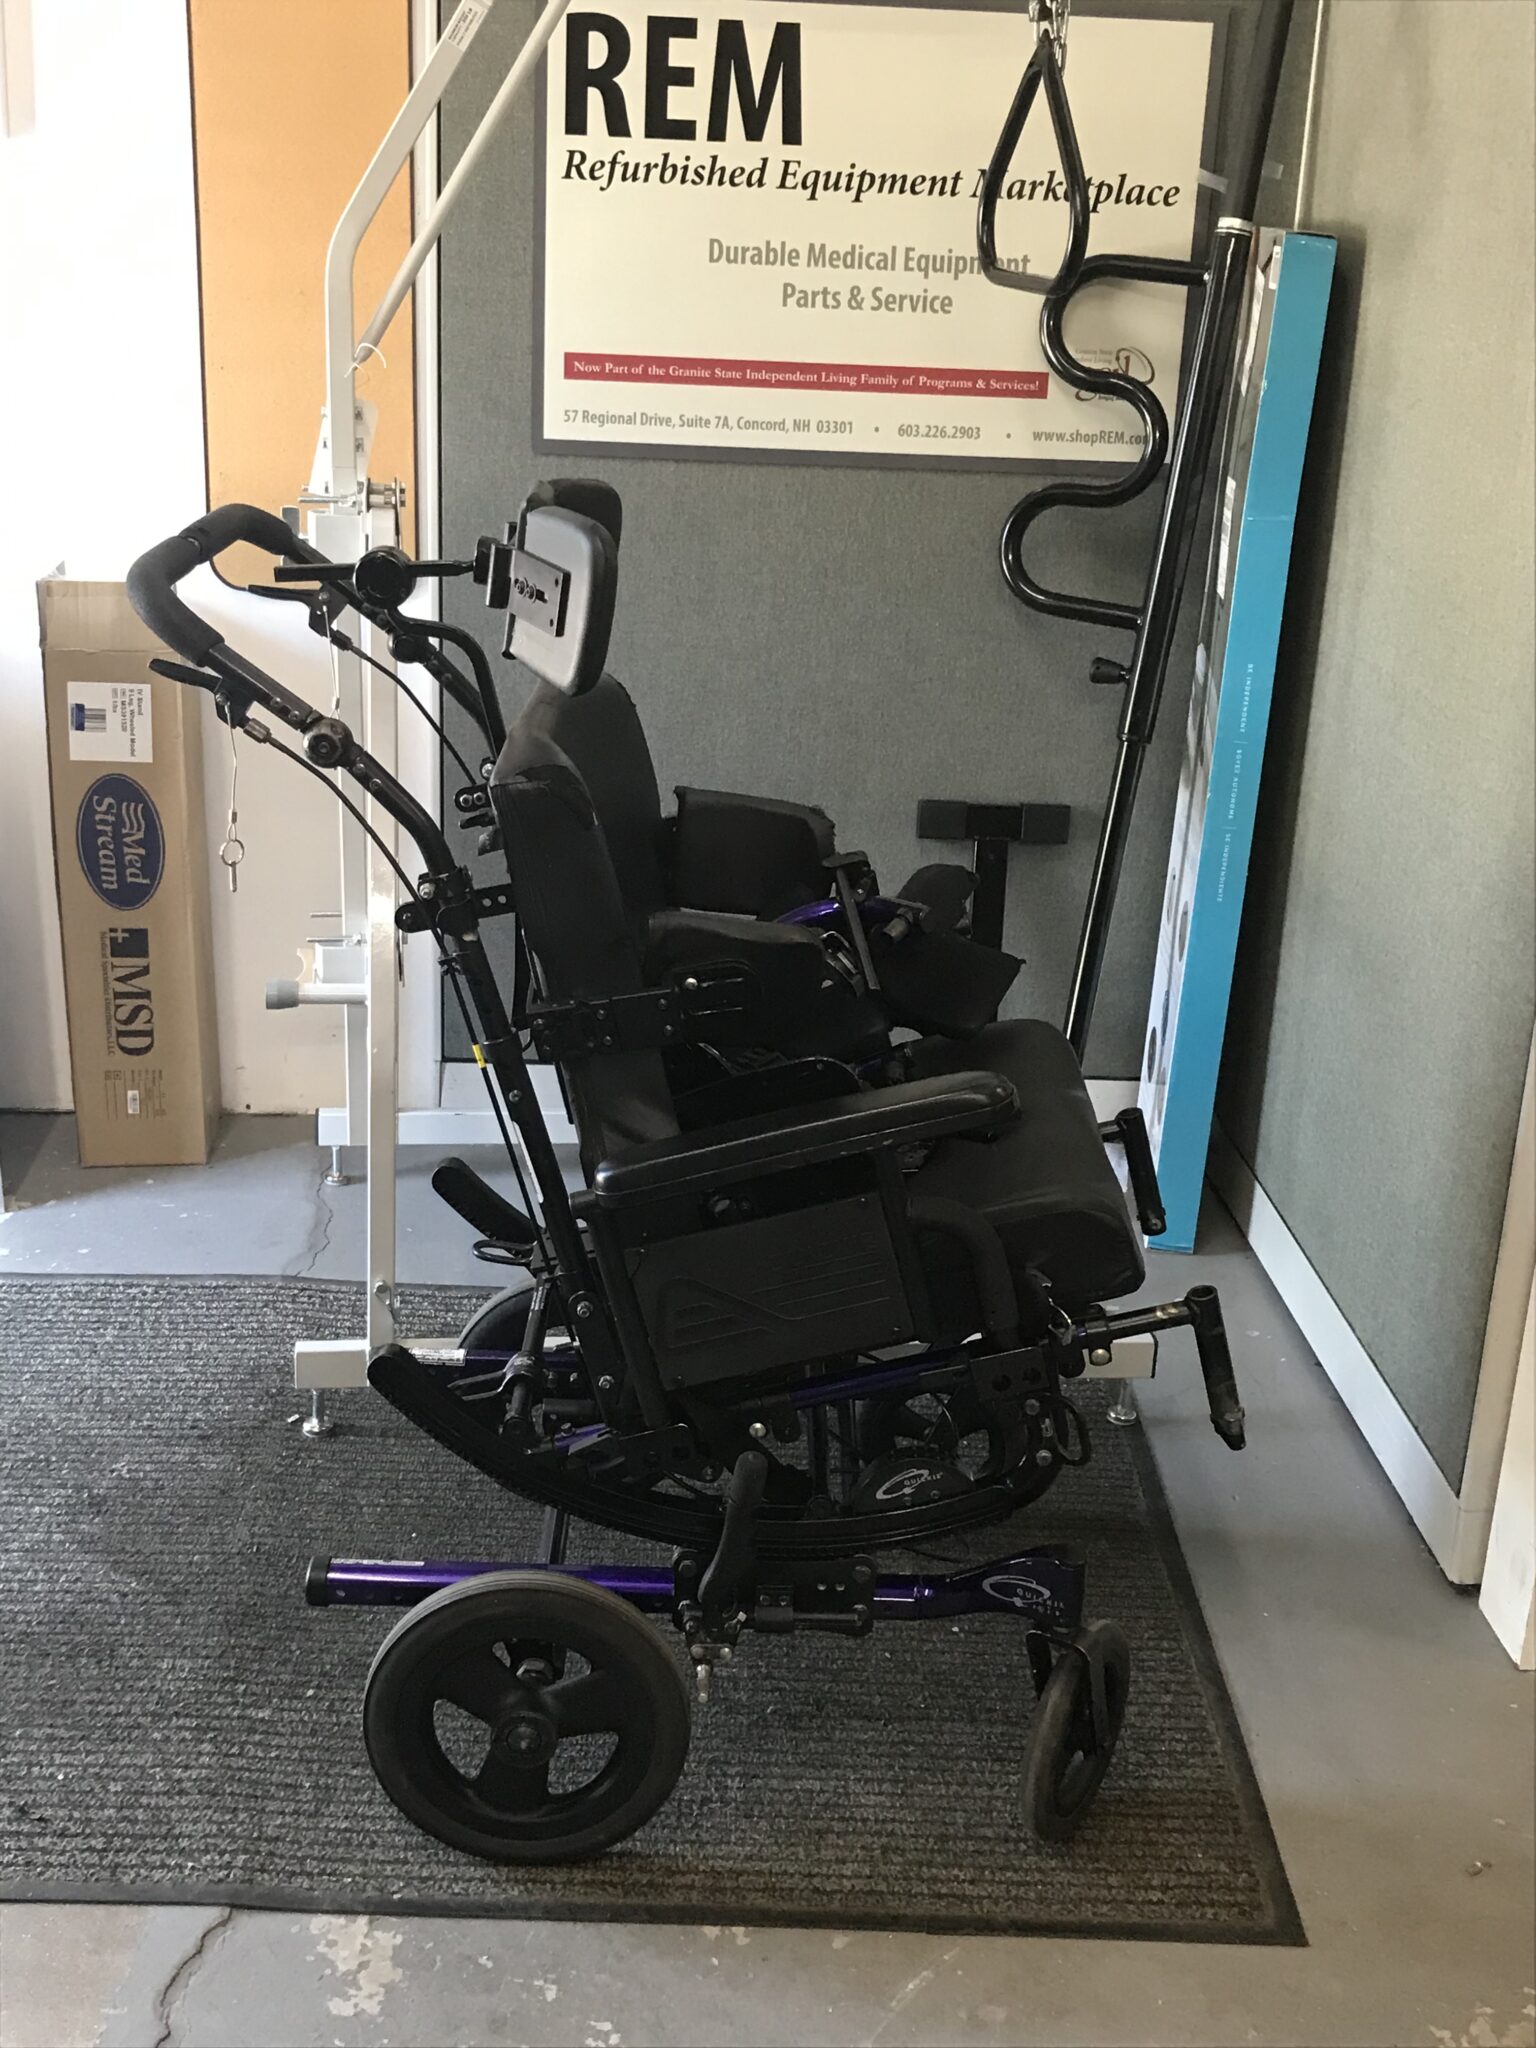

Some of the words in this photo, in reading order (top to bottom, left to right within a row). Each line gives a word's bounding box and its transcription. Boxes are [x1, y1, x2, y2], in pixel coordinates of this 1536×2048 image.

[565, 12, 802, 145] REM
[561, 149, 769, 191] Refurbished
[776, 159, 963, 203] Equipment
[969, 168, 1181, 214] arktplace
[708, 238, 801, 267] Durable
[806, 242, 897, 272] Medical
[782, 282, 841, 309] Parts
[847, 285, 865, 311] &
[870, 286, 953, 314] Service
[573, 360, 601, 373] Now
[605, 362, 628, 374] Part
[631, 364, 645, 375] of
[648, 365, 666, 376] the
[669, 366, 711, 378] Granite
[714, 368, 742, 379] State
[746, 369, 817, 383] Independent
[821, 372, 857, 387] Living
[860, 373, 899, 388] Family
[902, 375, 915, 386] of
[918, 376, 973, 390] Programs
[976, 378, 986, 389] &
[989, 379, 1040, 391] Services!
[564, 409, 579, 423] 57
[582, 409, 637, 428] Regional
[640, 412, 676, 429] Drive,
[679, 414, 711, 429] Suite
[714, 415, 734, 431] 7A,
[736, 416, 790, 434] Concord,
[793, 418, 811, 432] NH
[816, 419, 853, 434] 03301
[897, 424, 981, 440] 603.226.2903
[1240, 677, 1252, 733] INDEPENDENT
[93, 795, 118, 890] Stream
[122, 828, 151, 885] Med
[111, 961, 154, 1057] MSD
